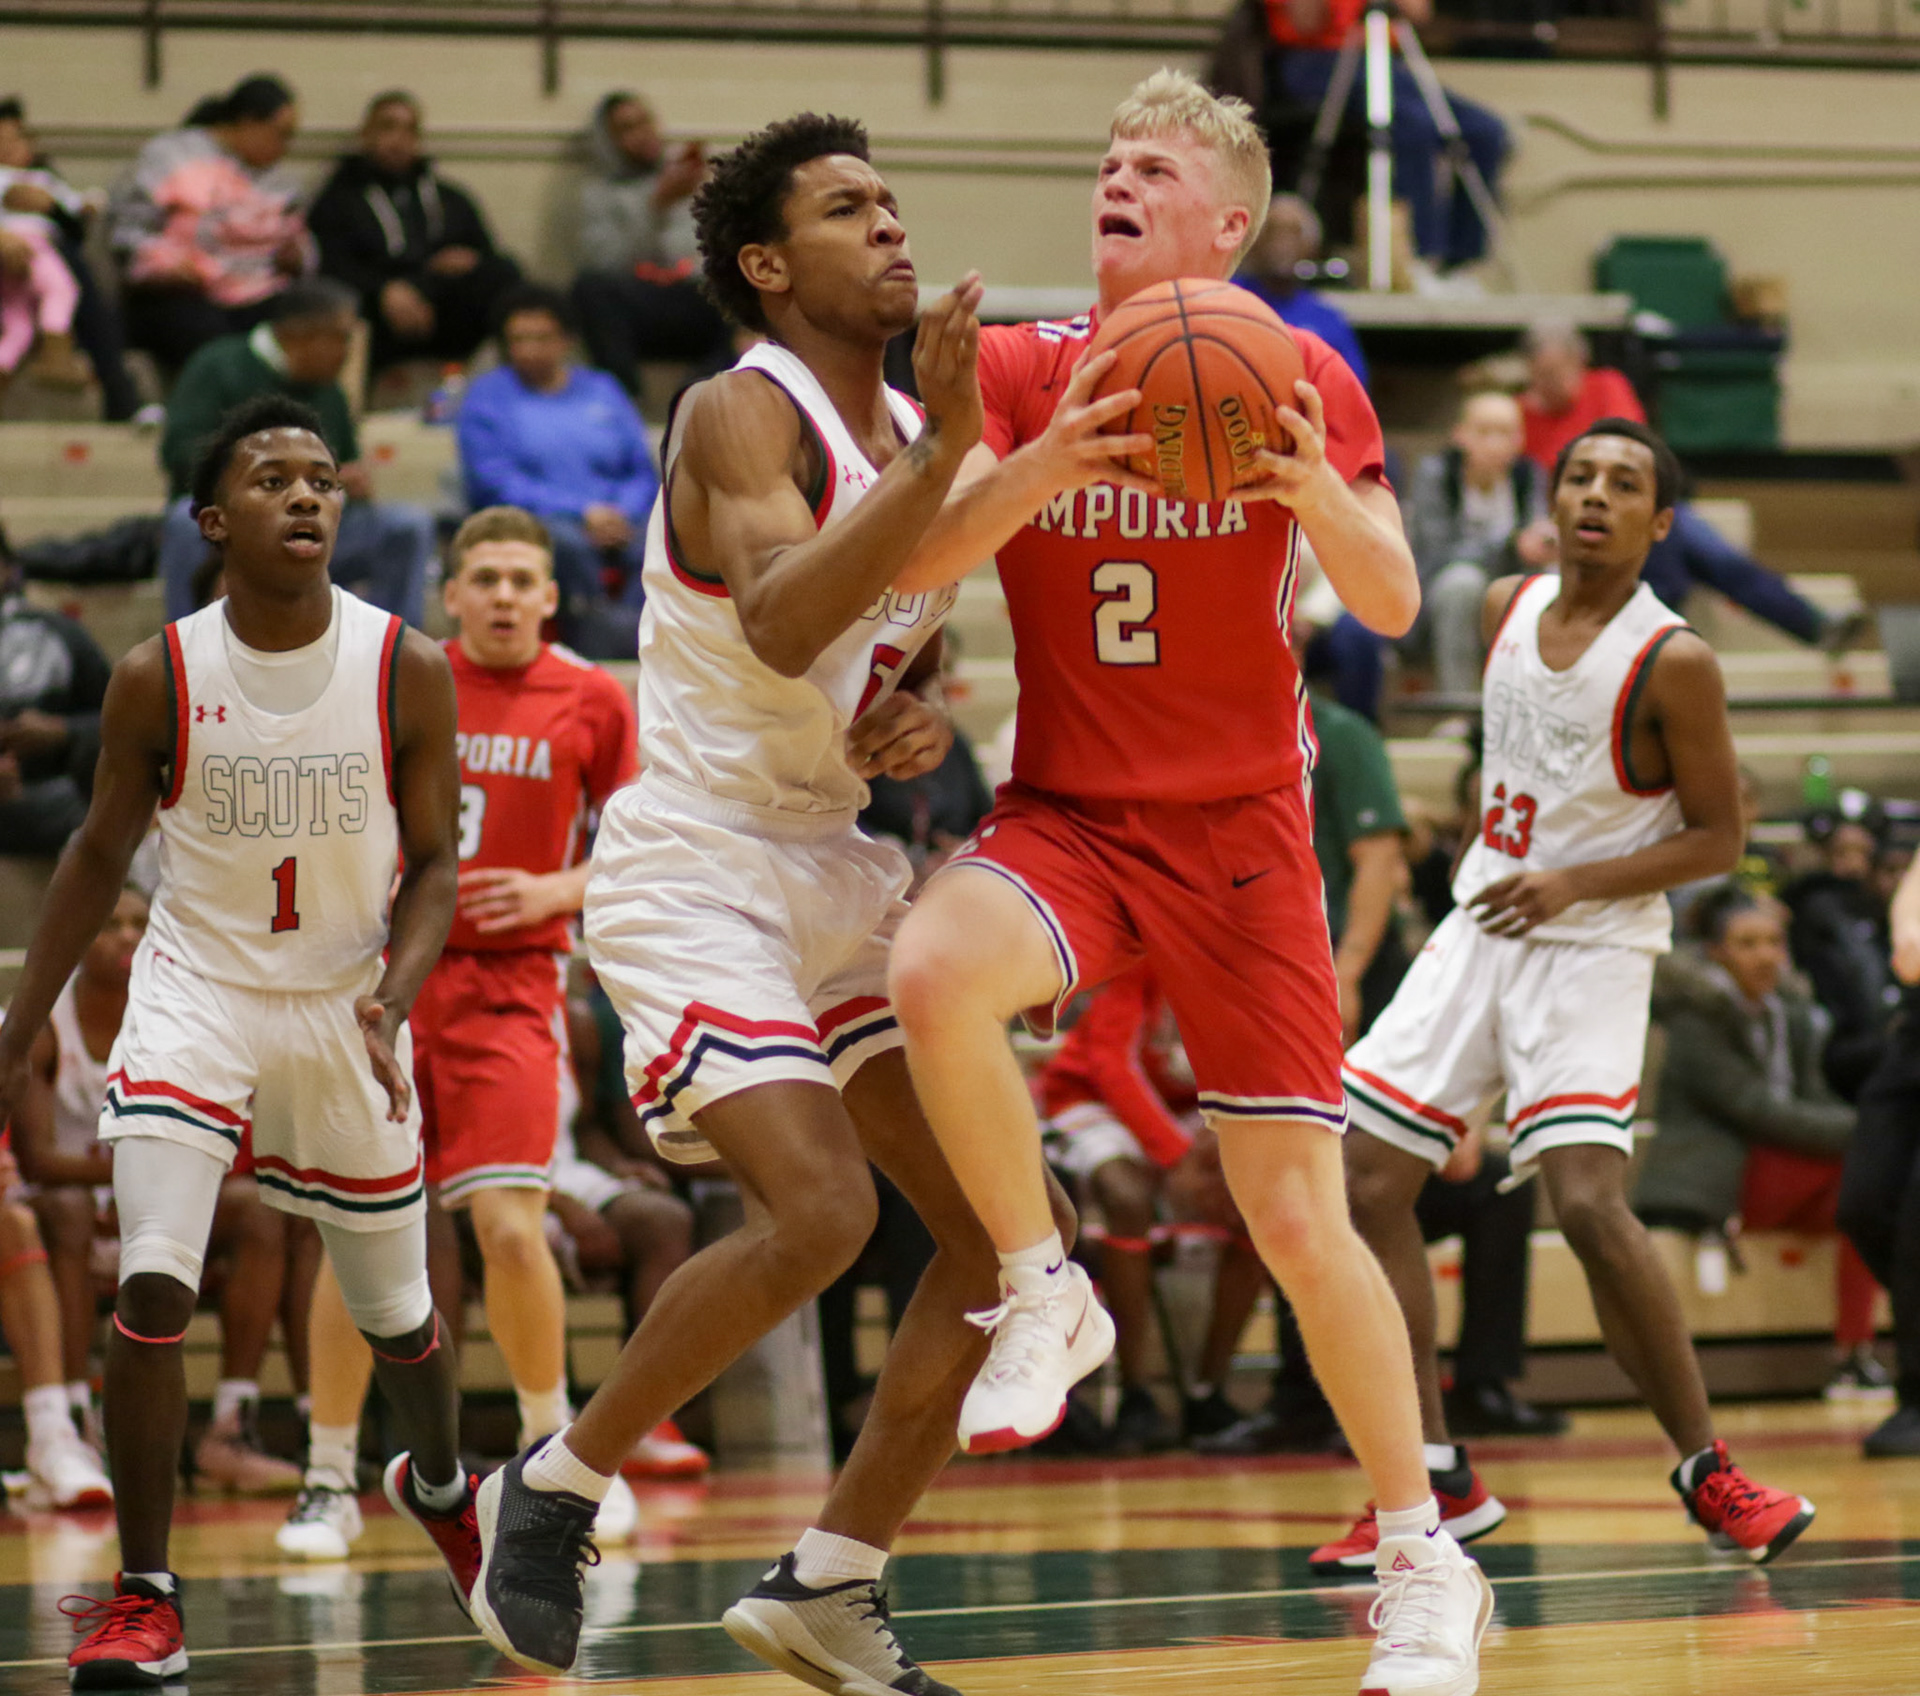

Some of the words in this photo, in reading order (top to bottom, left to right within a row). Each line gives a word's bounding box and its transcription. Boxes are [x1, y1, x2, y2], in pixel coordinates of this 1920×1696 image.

[1029, 484, 1248, 539] MPORIA
[1090, 559, 1161, 666] 2
[202, 752, 370, 838] SCOTS
[455, 731, 552, 781] PORIA
[270, 856, 300, 934] 1
